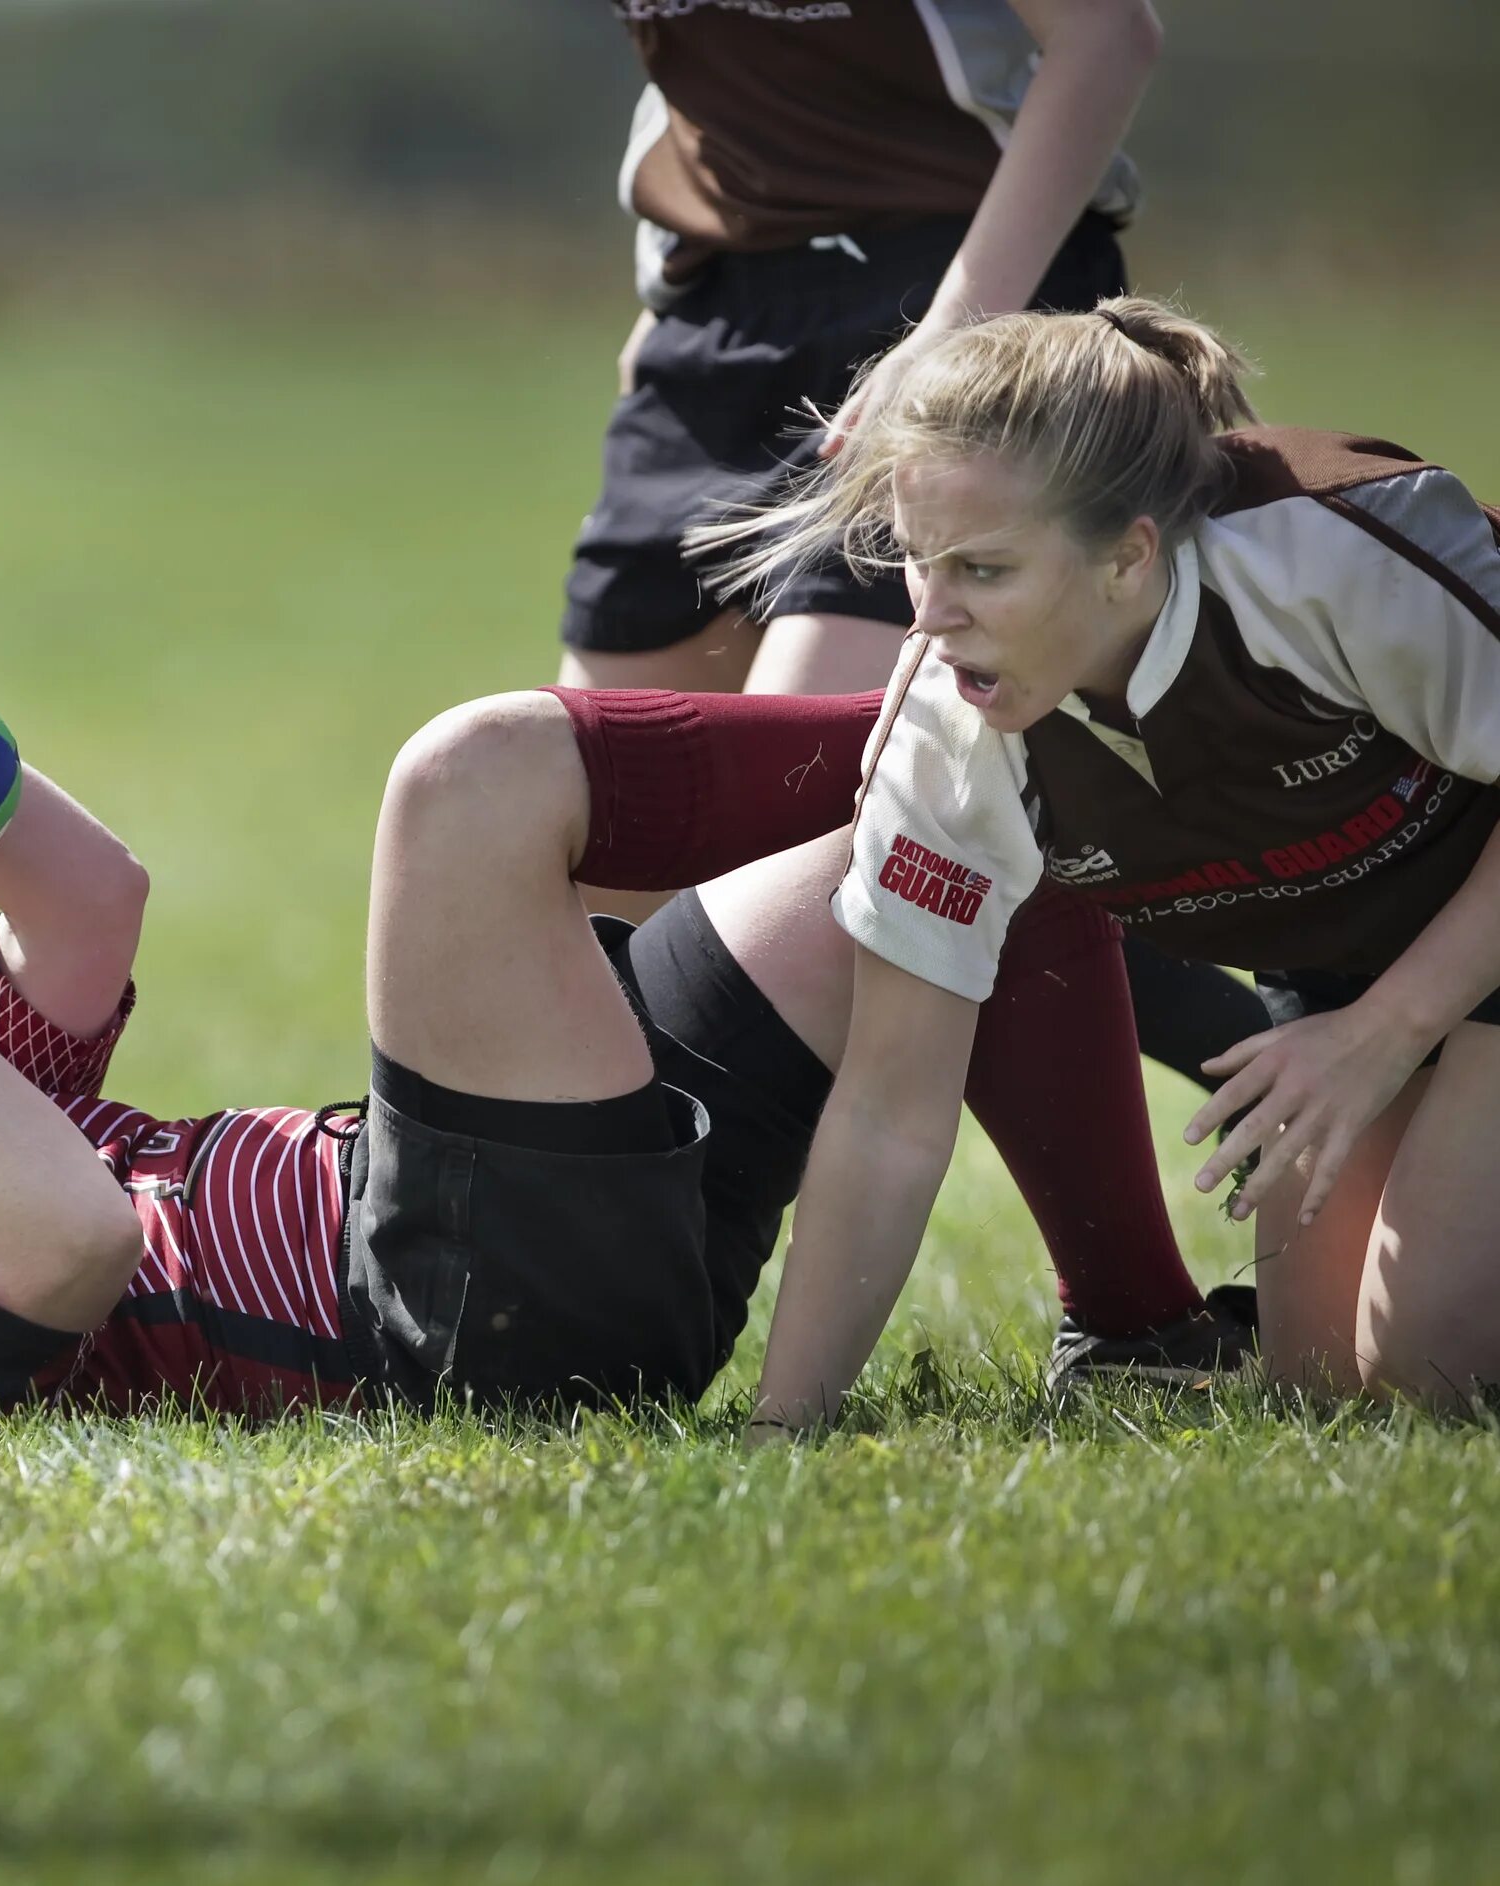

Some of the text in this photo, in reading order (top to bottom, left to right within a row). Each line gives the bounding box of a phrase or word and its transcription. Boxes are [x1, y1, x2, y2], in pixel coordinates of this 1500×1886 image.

[1273, 715, 1376, 788] LURFC
[891, 833, 971, 885] NATIONAL
[1261, 794, 1404, 878] GUARD
[878, 854, 983, 926] GUARD
